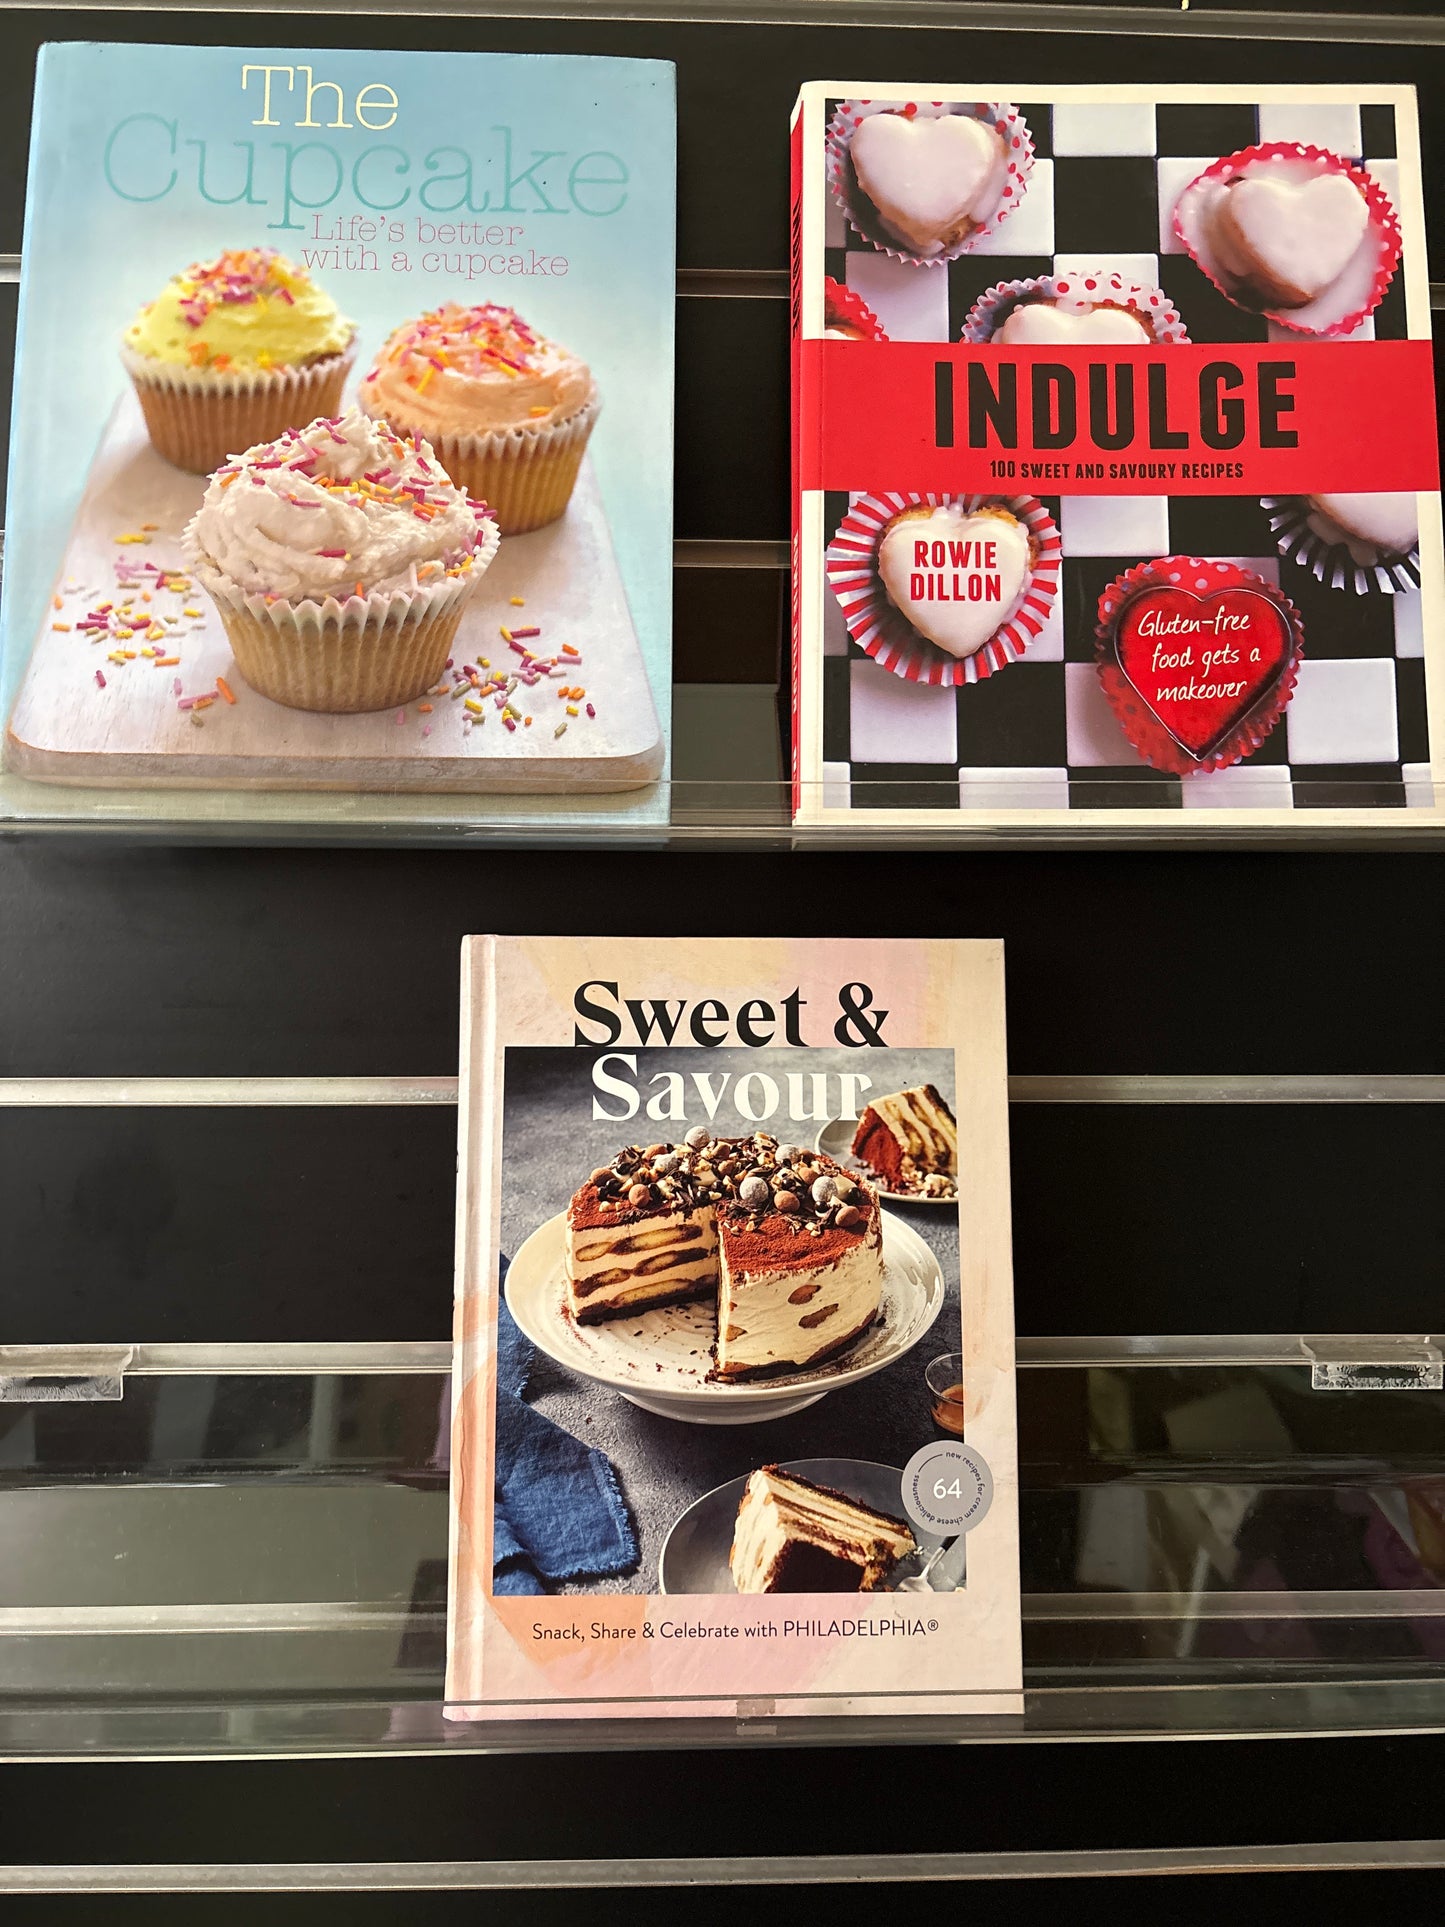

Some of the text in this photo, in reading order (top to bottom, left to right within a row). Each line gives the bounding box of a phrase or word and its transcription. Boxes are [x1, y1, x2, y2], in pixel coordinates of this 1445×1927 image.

[242, 65, 399, 130] The
[104, 112, 630, 231] Cupcake
[311, 214, 525, 246] Life's better
[301, 244, 569, 280] with a cupcake
[934, 361, 1299, 451] INDULGE
[990, 460, 1244, 479] 100 SWEET AND SAVOURY RECIPES
[914, 540, 997, 569] ROWIE
[910, 573, 1001, 602] DILLON
[1137, 605, 1251, 638] Gluten-free
[1151, 643, 1262, 678] food gets a
[1157, 675, 1248, 703] makeover
[573, 980, 890, 1048] Sweet &
[591, 1052, 873, 1122] Savour
[912, 1451, 986, 1526] new recipes for cream cheese deliciousness
[933, 1478, 962, 1499] 64
[532, 1622, 585, 1643] Snack,
[590, 1622, 637, 1639] Share
[642, 1621, 655, 1639] &
[660, 1621, 740, 1639] Celebrate
[744, 1620, 778, 1637] with
